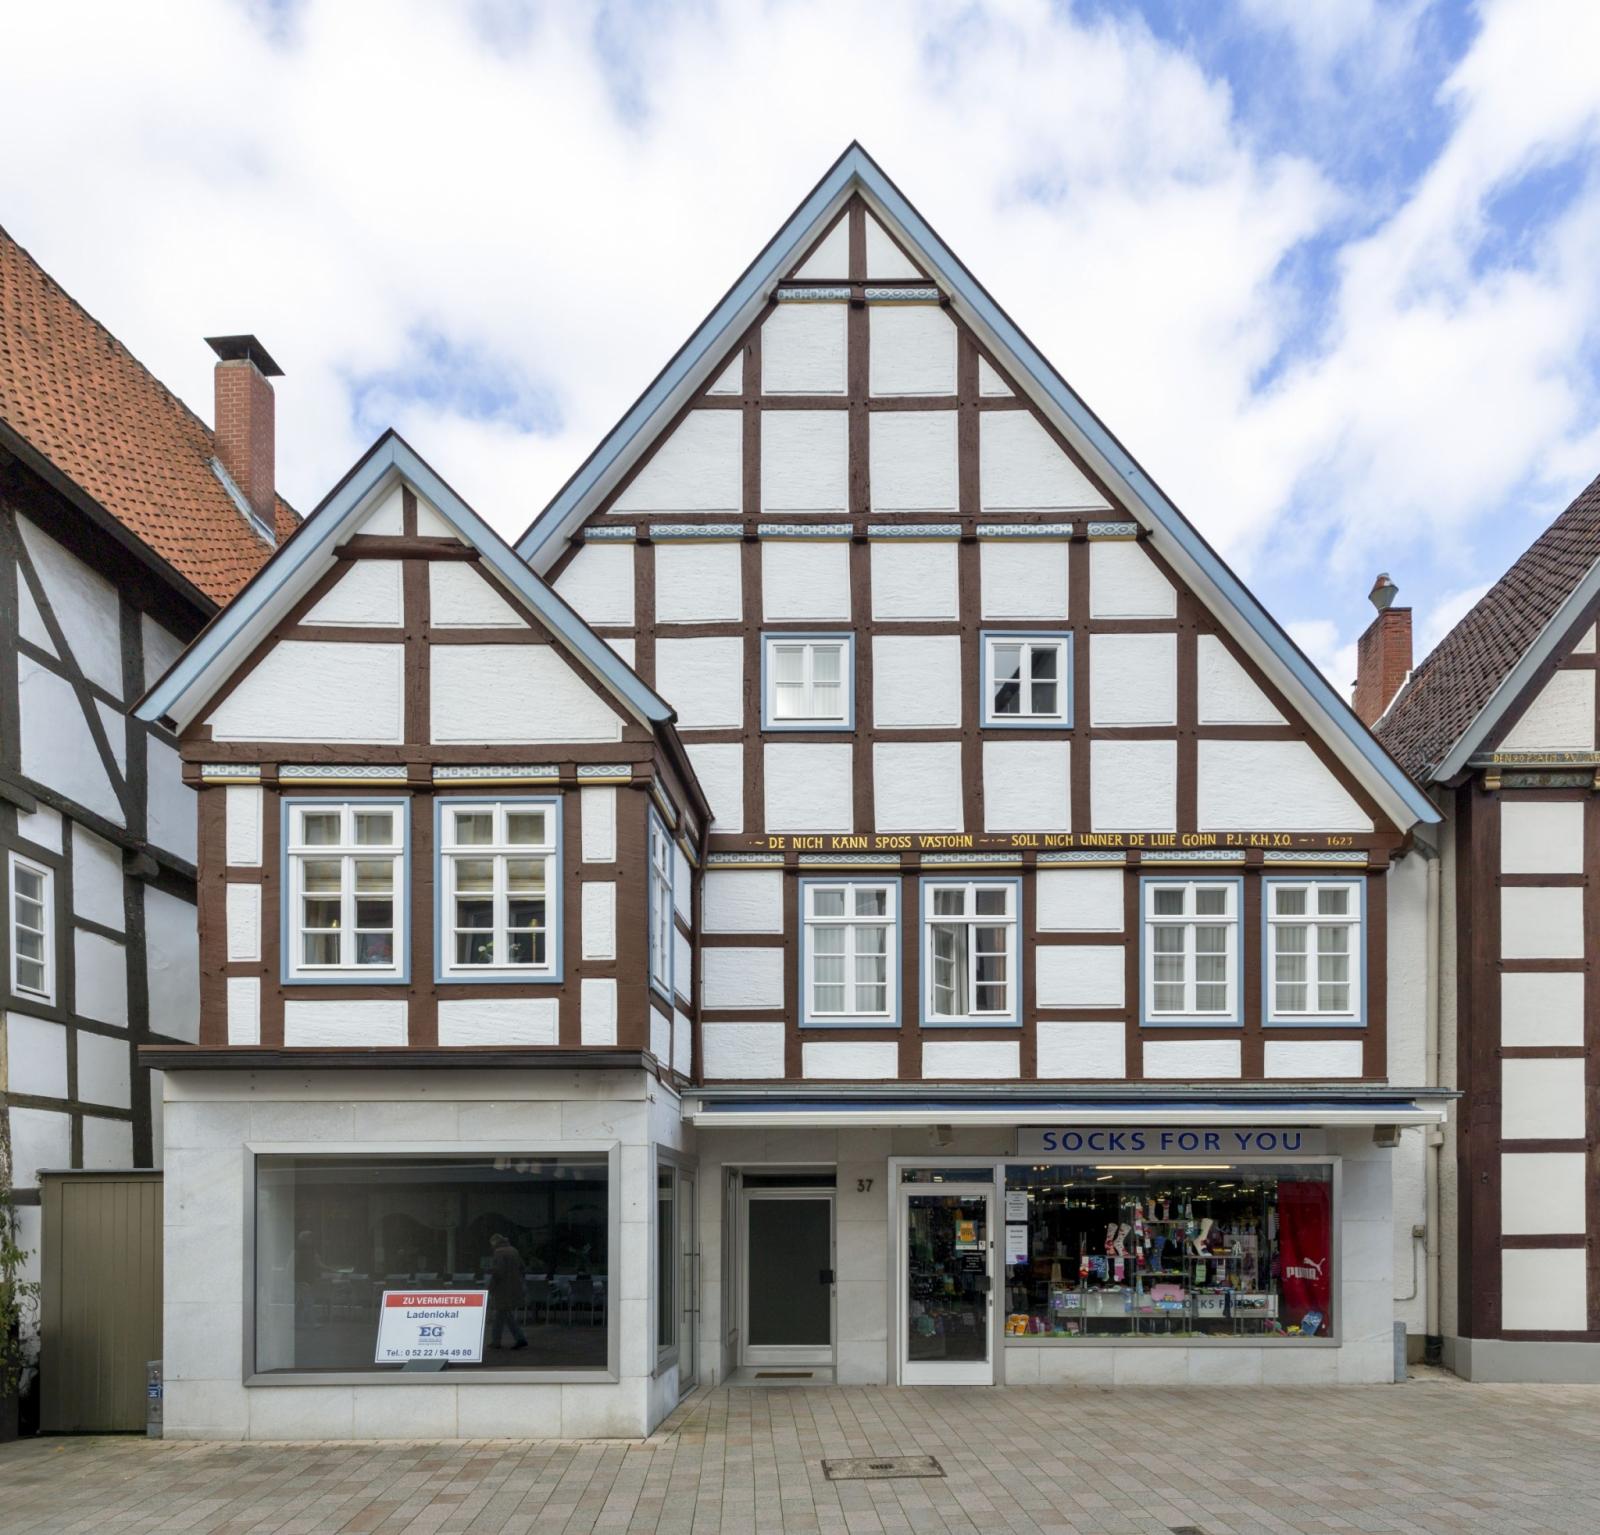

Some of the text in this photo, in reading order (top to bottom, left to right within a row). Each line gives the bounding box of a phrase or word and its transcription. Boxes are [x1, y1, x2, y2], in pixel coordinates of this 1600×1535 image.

[768, 837, 785, 849] DE
[793, 837, 823, 849] NICH
[875, 836, 912, 849] SPOSS
[1011, 834, 1039, 846] SOLL
[1045, 834, 1074, 846] NICH
[1080, 834, 1123, 846] UNNER
[1129, 834, 1145, 846] DE
[1182, 834, 1217, 846] GOHN
[1043, 1132, 1302, 1151] SOCKS FOR YOU
[857, 1178, 874, 1193] 37
[416, 1296, 466, 1304] VERMIETEN
[406, 1310, 459, 1319] Ladenlokal
[418, 1326, 445, 1337] EG
[386, 1349, 403, 1357] Tel.:
